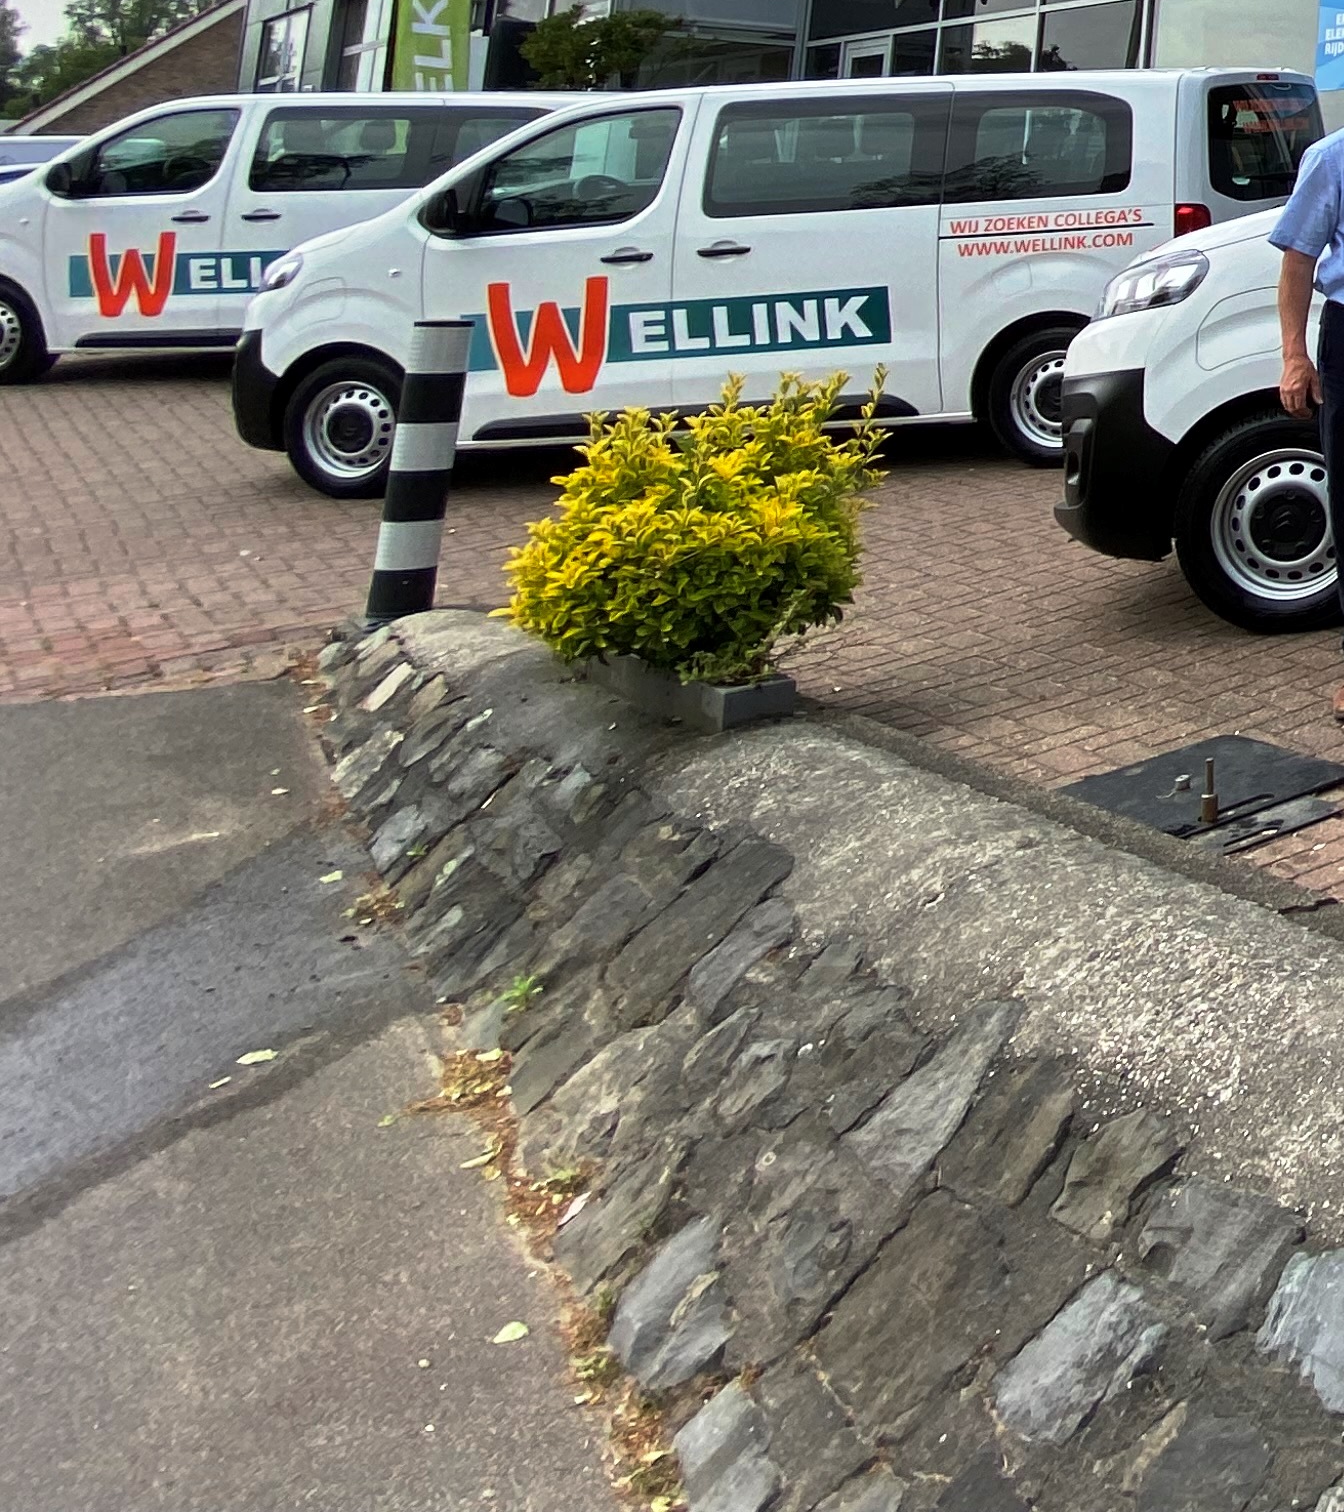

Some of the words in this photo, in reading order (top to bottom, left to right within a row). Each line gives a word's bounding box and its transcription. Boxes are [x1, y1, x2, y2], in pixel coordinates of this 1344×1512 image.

[950, 219, 979, 234] WIJ
[983, 215, 1049, 232] ZOEKEN
[1053, 208, 1142, 227] COLLEGA'S
[957, 232, 1134, 257] WWW.WELLINK.COM
[486, 275, 874, 398] WELLINK
